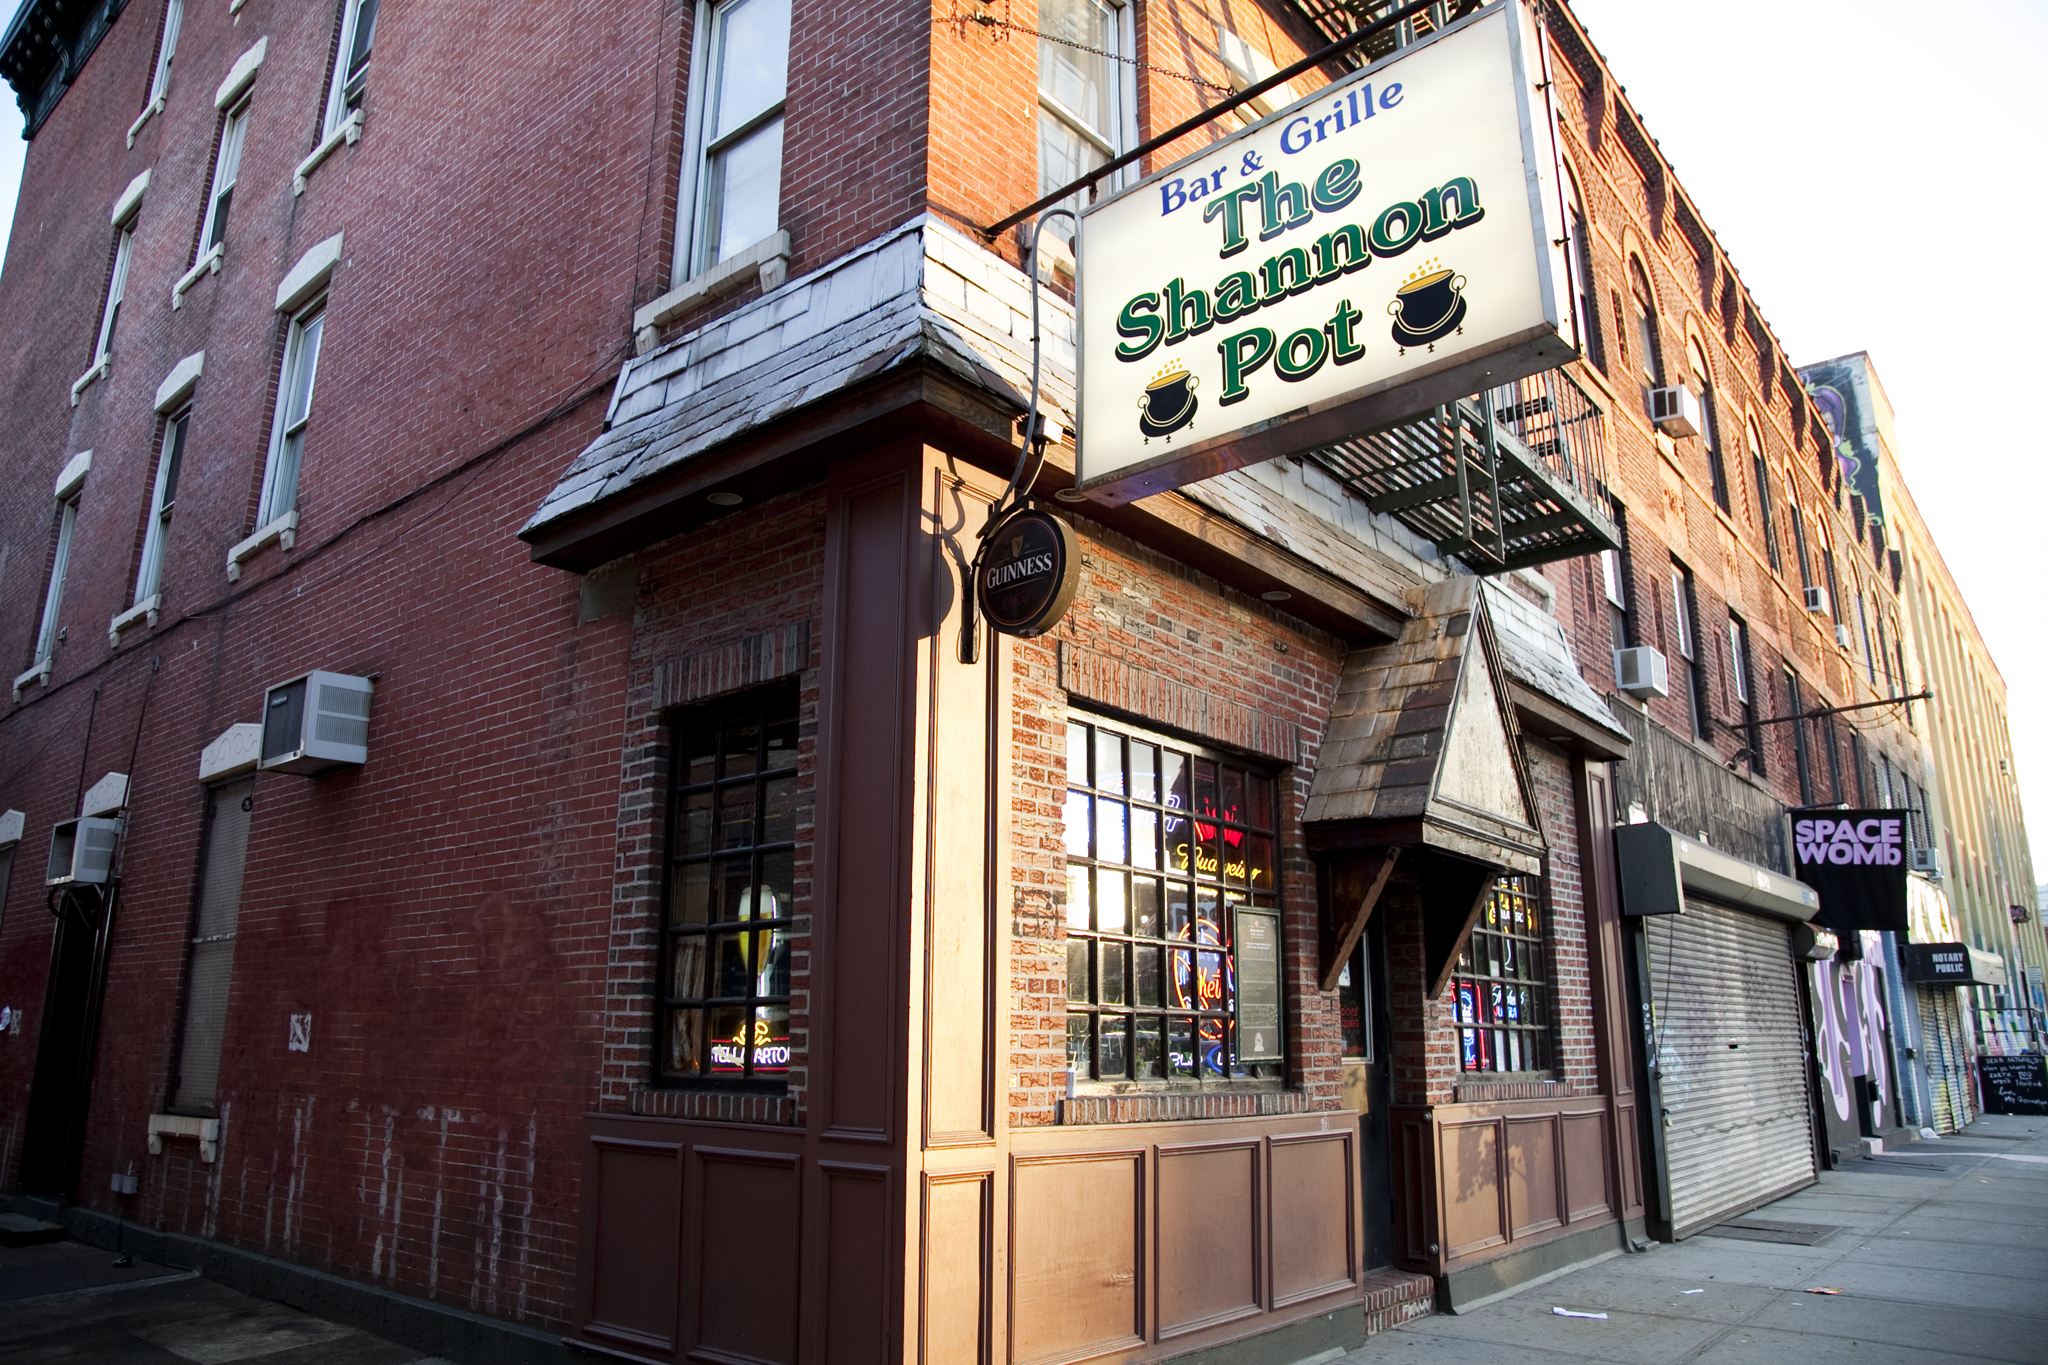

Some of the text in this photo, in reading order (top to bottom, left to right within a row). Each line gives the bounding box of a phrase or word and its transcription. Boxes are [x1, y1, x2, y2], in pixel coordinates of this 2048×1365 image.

[1159, 82, 1405, 216] Bar & Grille
[1203, 157, 1363, 259] The
[1115, 176, 1485, 362] Shannon
[1218, 299, 1366, 406] Pot
[987, 552, 1052, 589] GUINNESS
[1795, 819, 1902, 843] SPACE
[1932, 953, 1964, 963] NOTARY
[1935, 963, 1964, 973] PUBLIC
